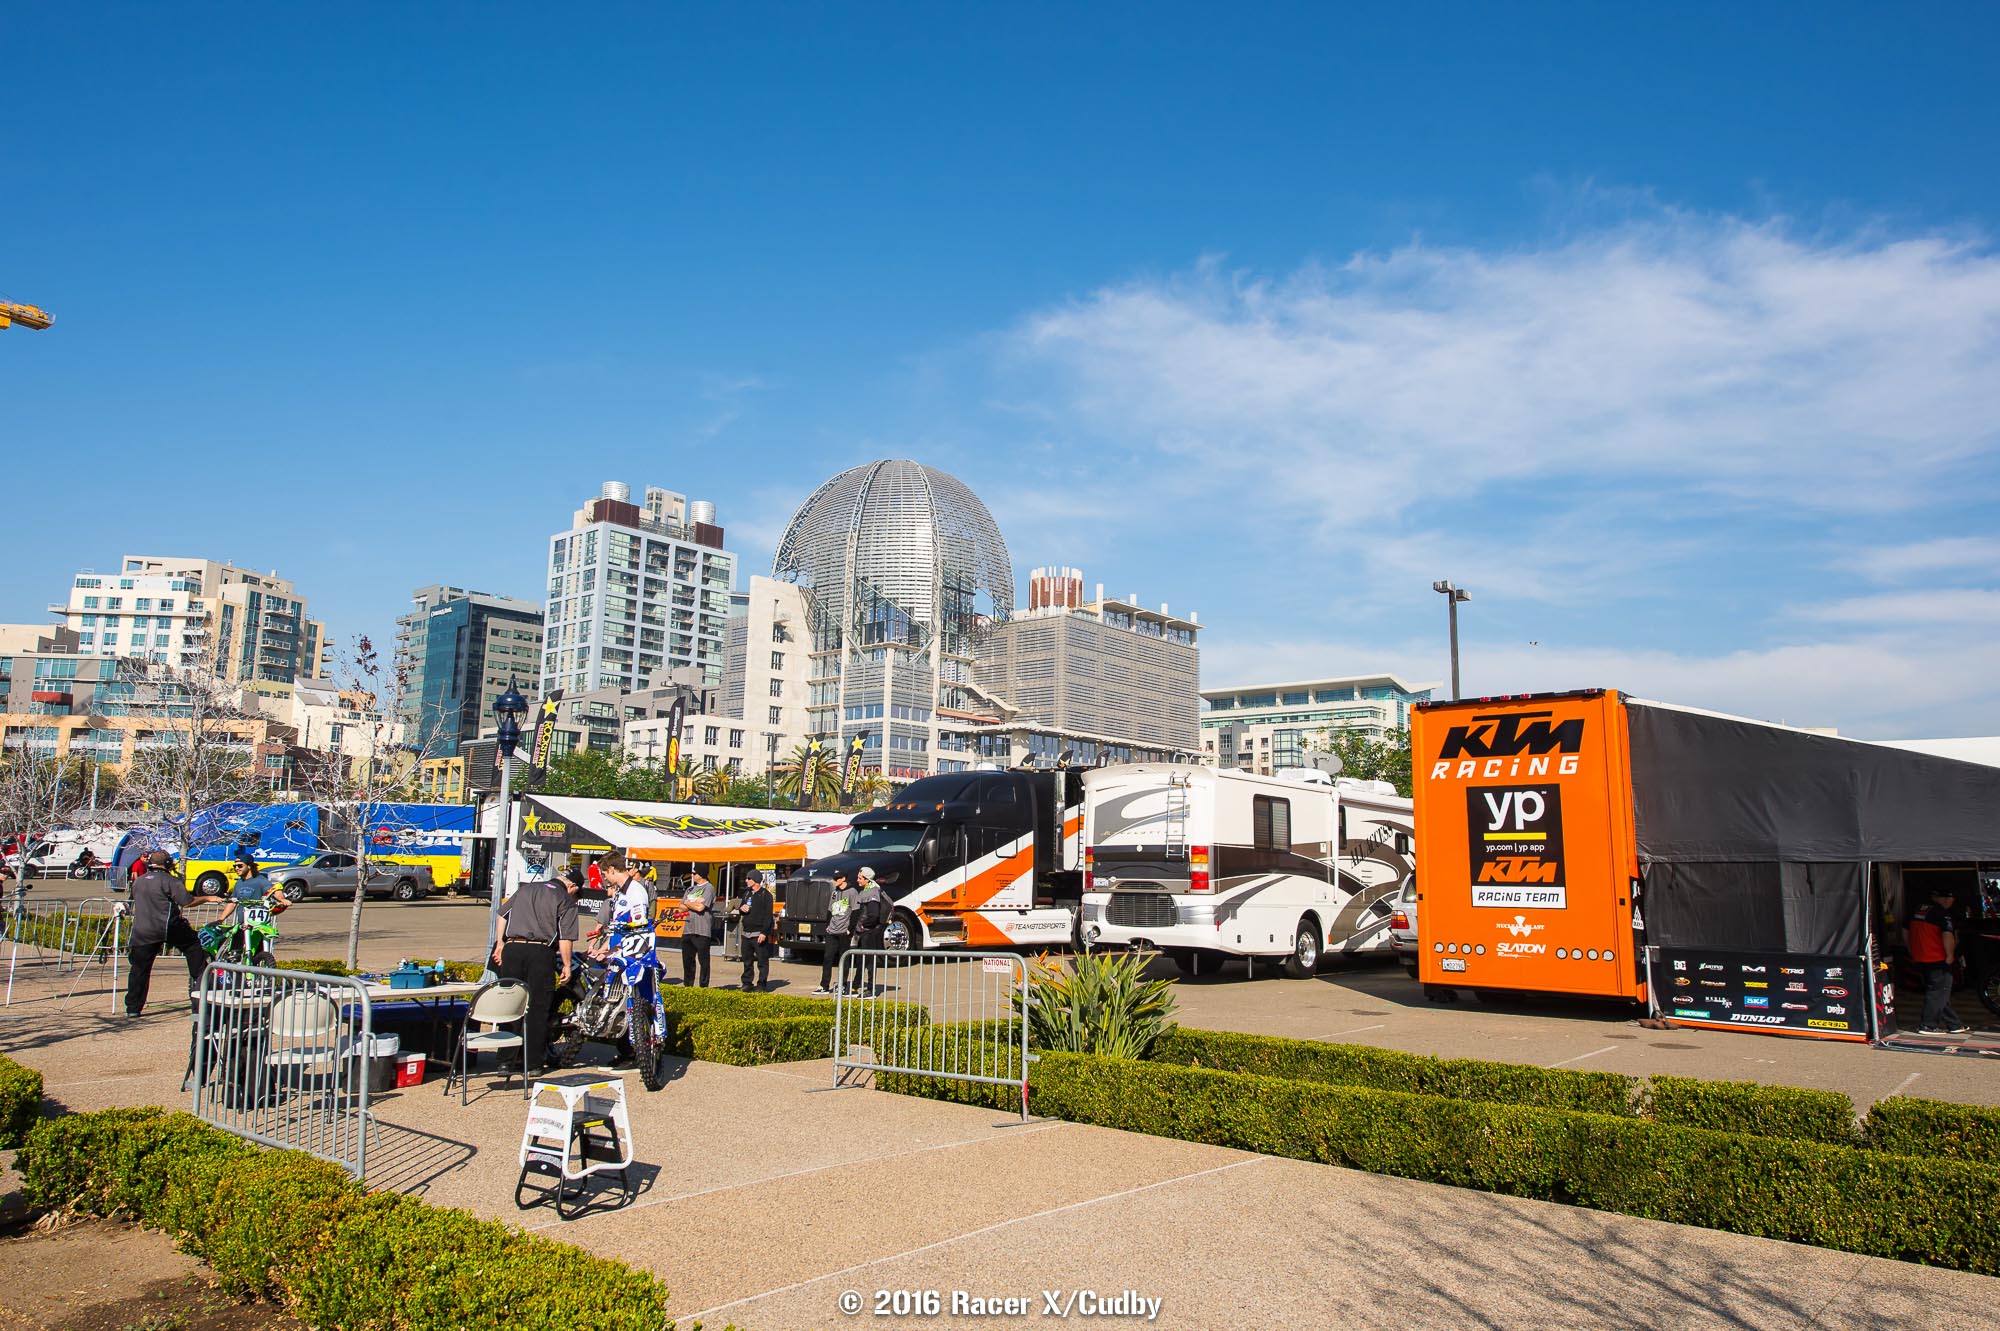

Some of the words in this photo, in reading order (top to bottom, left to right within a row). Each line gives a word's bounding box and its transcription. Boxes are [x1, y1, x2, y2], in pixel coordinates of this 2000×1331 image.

[1439, 711, 1585, 759] KTM
[536, 721, 554, 769] ROCKSTAR
[804, 756, 818, 795] ROCKSTAR
[845, 754, 861, 795] ROCKSTAR
[1484, 791, 1545, 831] yp
[538, 822, 566, 832] ROCKSTAR
[1486, 844, 1513, 853] yp.com
[1518, 844, 1529, 853] yp
[1529, 844, 1545, 853] app
[1477, 857, 1557, 883] KTM
[1526, 893, 1559, 902] TEAM
[248, 910, 270, 924] 447
[1496, 943, 1546, 954] SLATON
[1780, 967, 1805, 975] XTRIG
[1730, 1014, 1786, 1024] DUNLOP
